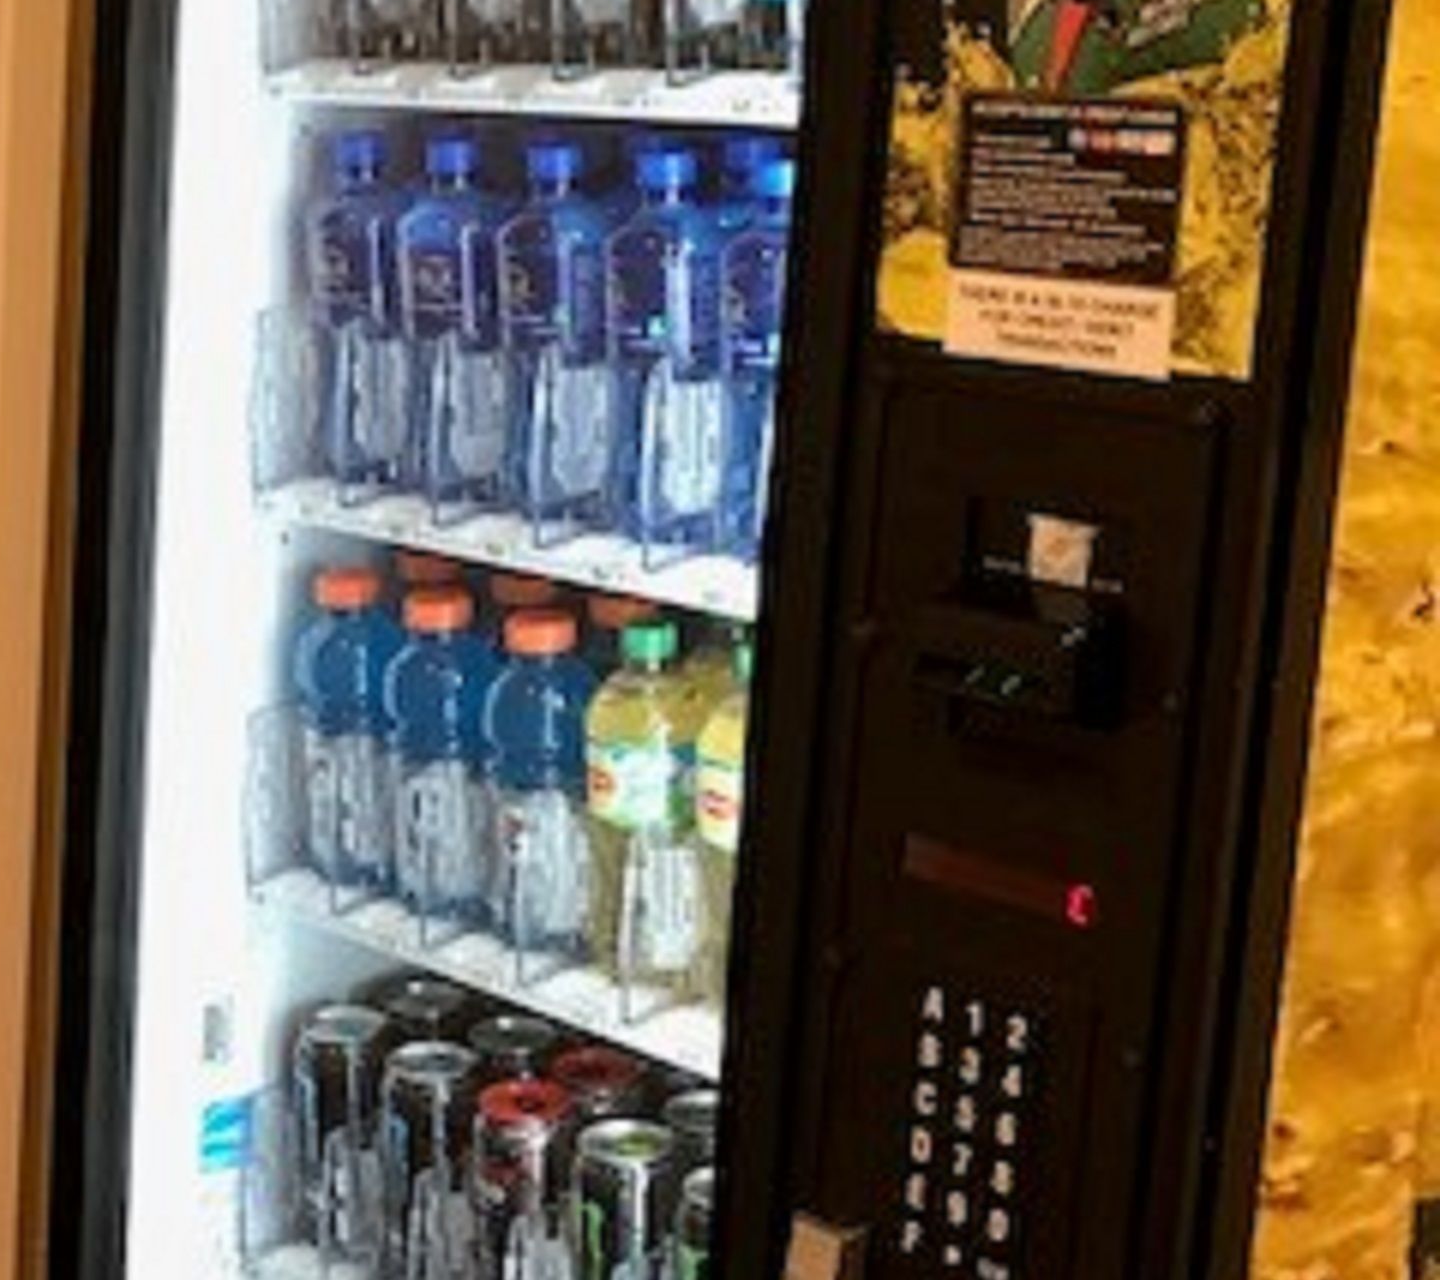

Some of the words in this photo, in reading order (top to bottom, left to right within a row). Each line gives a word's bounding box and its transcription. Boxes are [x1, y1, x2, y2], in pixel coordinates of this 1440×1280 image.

[923, 986, 943, 1021] A
[966, 1001, 983, 1037] 1
[1007, 1014, 1028, 1052] 2
[915, 1080, 938, 1117] C
